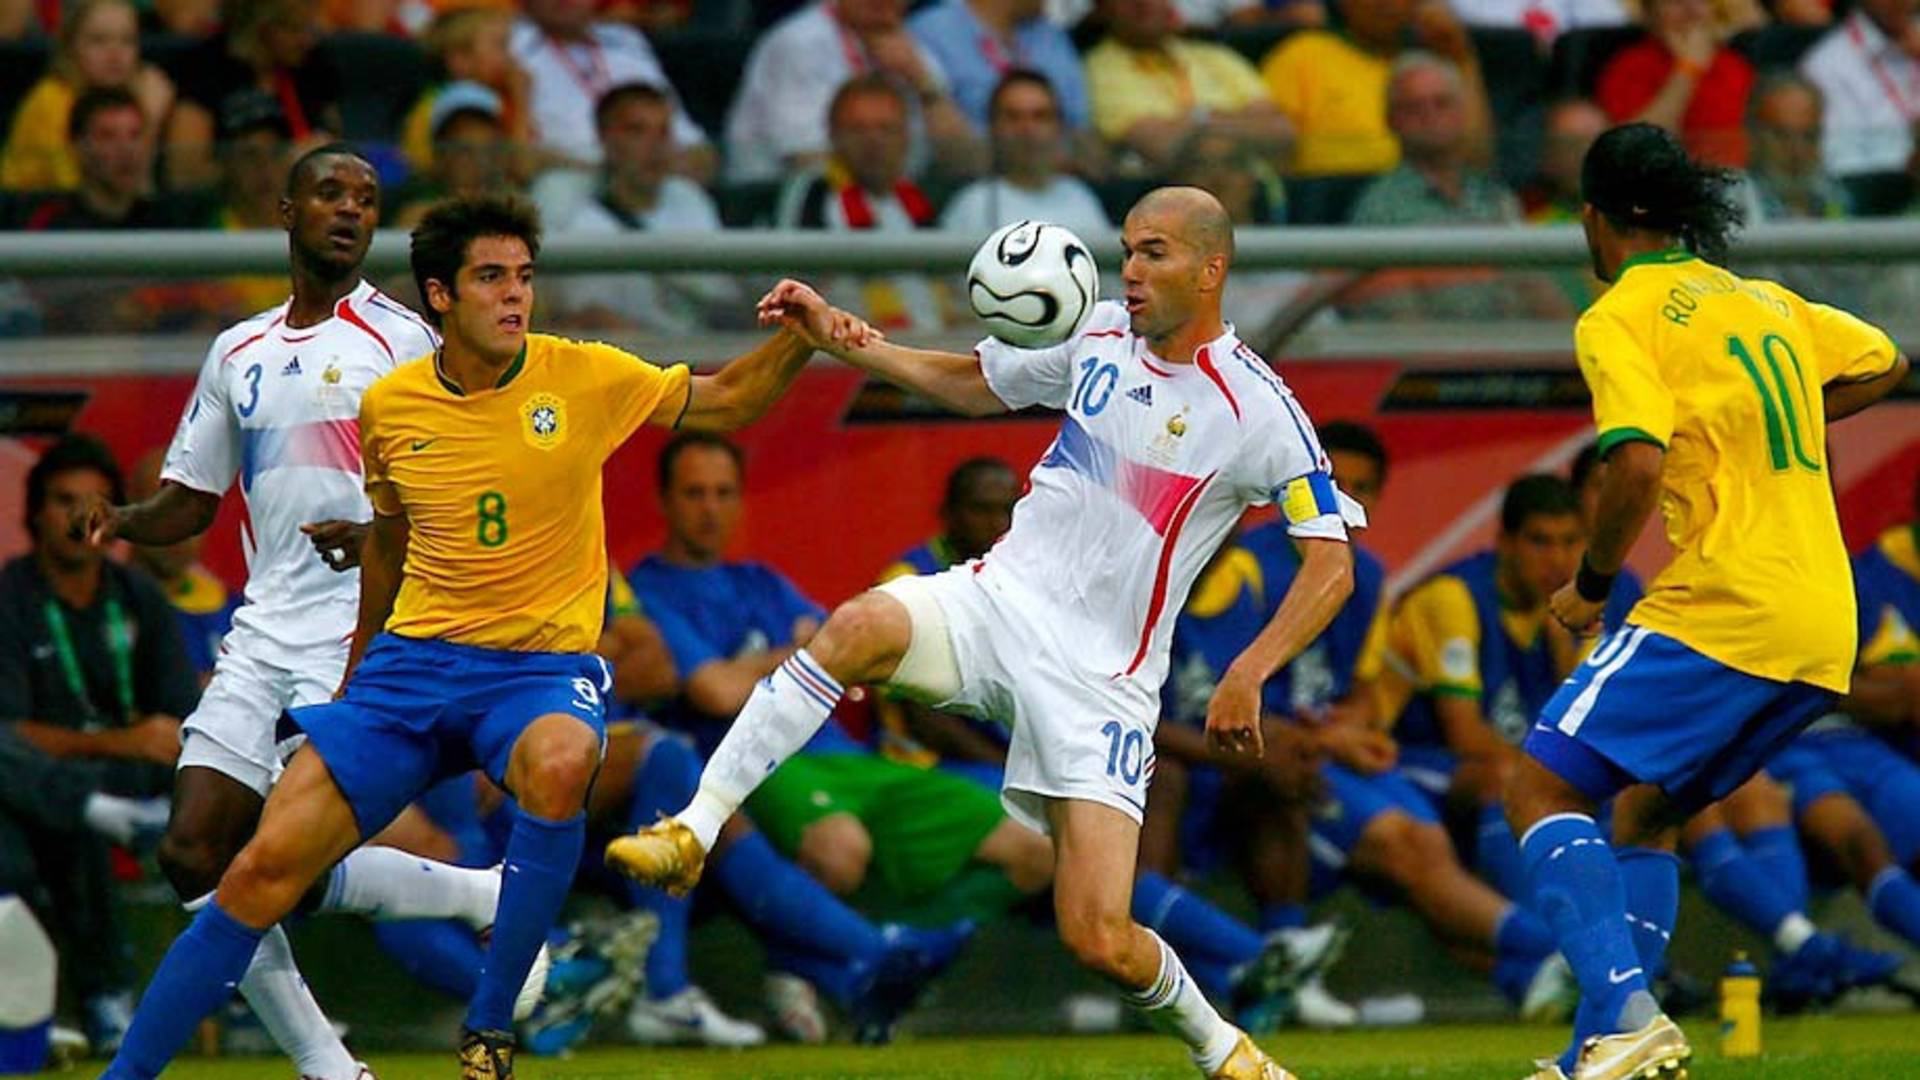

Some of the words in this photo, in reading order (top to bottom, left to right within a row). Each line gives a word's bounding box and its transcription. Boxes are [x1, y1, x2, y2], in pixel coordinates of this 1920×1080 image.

[238, 363, 262, 418] 3
[1072, 356, 1119, 416] 10
[1727, 335, 1821, 471] 10
[477, 491, 508, 547] 8
[570, 677, 599, 705] 8
[1101, 721, 1143, 786] 10
